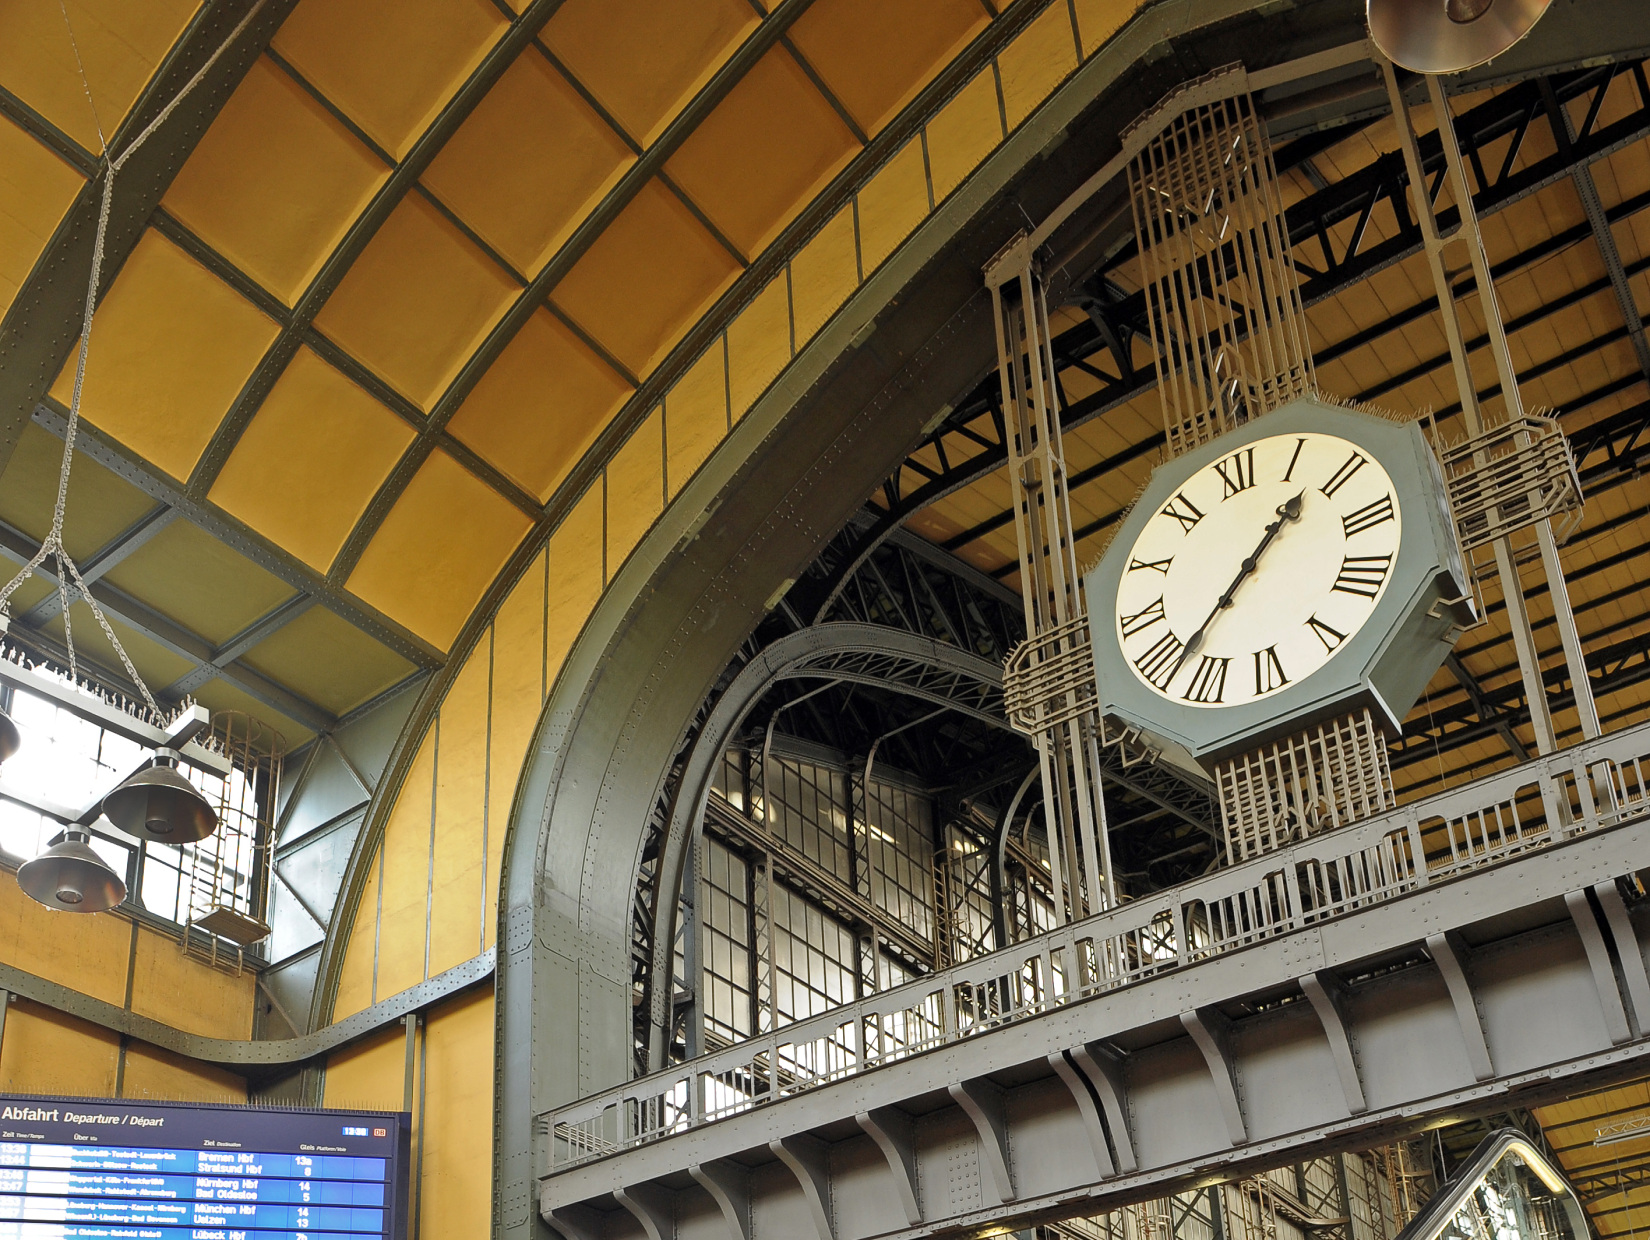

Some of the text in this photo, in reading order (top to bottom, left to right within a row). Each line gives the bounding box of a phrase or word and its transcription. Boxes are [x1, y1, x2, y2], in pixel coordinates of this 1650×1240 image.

[1211, 446, 1258, 503] XII
[1318, 450, 1370, 500] II
[1158, 490, 1207, 537] XI
[1341, 491, 1395, 541] III
[1126, 554, 1176, 577] X
[1330, 551, 1394, 602] IIII
[1120, 593, 1167, 642] IX
[1302, 612, 1350, 656] V
[1181, 655, 1235, 704] VII
[1251, 642, 1292, 696] VI
[1, 1106, 59, 1122] Abfahrt
[63, 1112, 120, 1125] Departure
[130, 1116, 164, 1128] Départ
[2, 1130, 14, 1138] Zeit
[74, 1132, 89, 1140] Über
[198, 1152, 235, 1163] Bremen
[238, 1153, 254, 1163] Hbf
[295, 1156, 312, 1166] 13a
[198, 1163, 243, 1174] Stralsund
[246, 1164, 262, 1175] Hbf
[196, 1177, 239, 1190] Nürnberg
[242, 1180, 258, 1190] Hbf
[299, 1182, 310, 1192] 14
[196, 1188, 214, 1199] Bad
[217, 1190, 258, 1200] Oldesloe
[302, 1192, 310, 1202] 5
[194, 1203, 237, 1214] München
[240, 1205, 256, 1215] Hbf
[297, 1208, 309, 1218] 14
[194, 1215, 226, 1225] Uelzen
[297, 1218, 308, 1228] 13
[192, 1230, 226, 1240] Lübeck
[229, 1231, 246, 1240] Hbf
